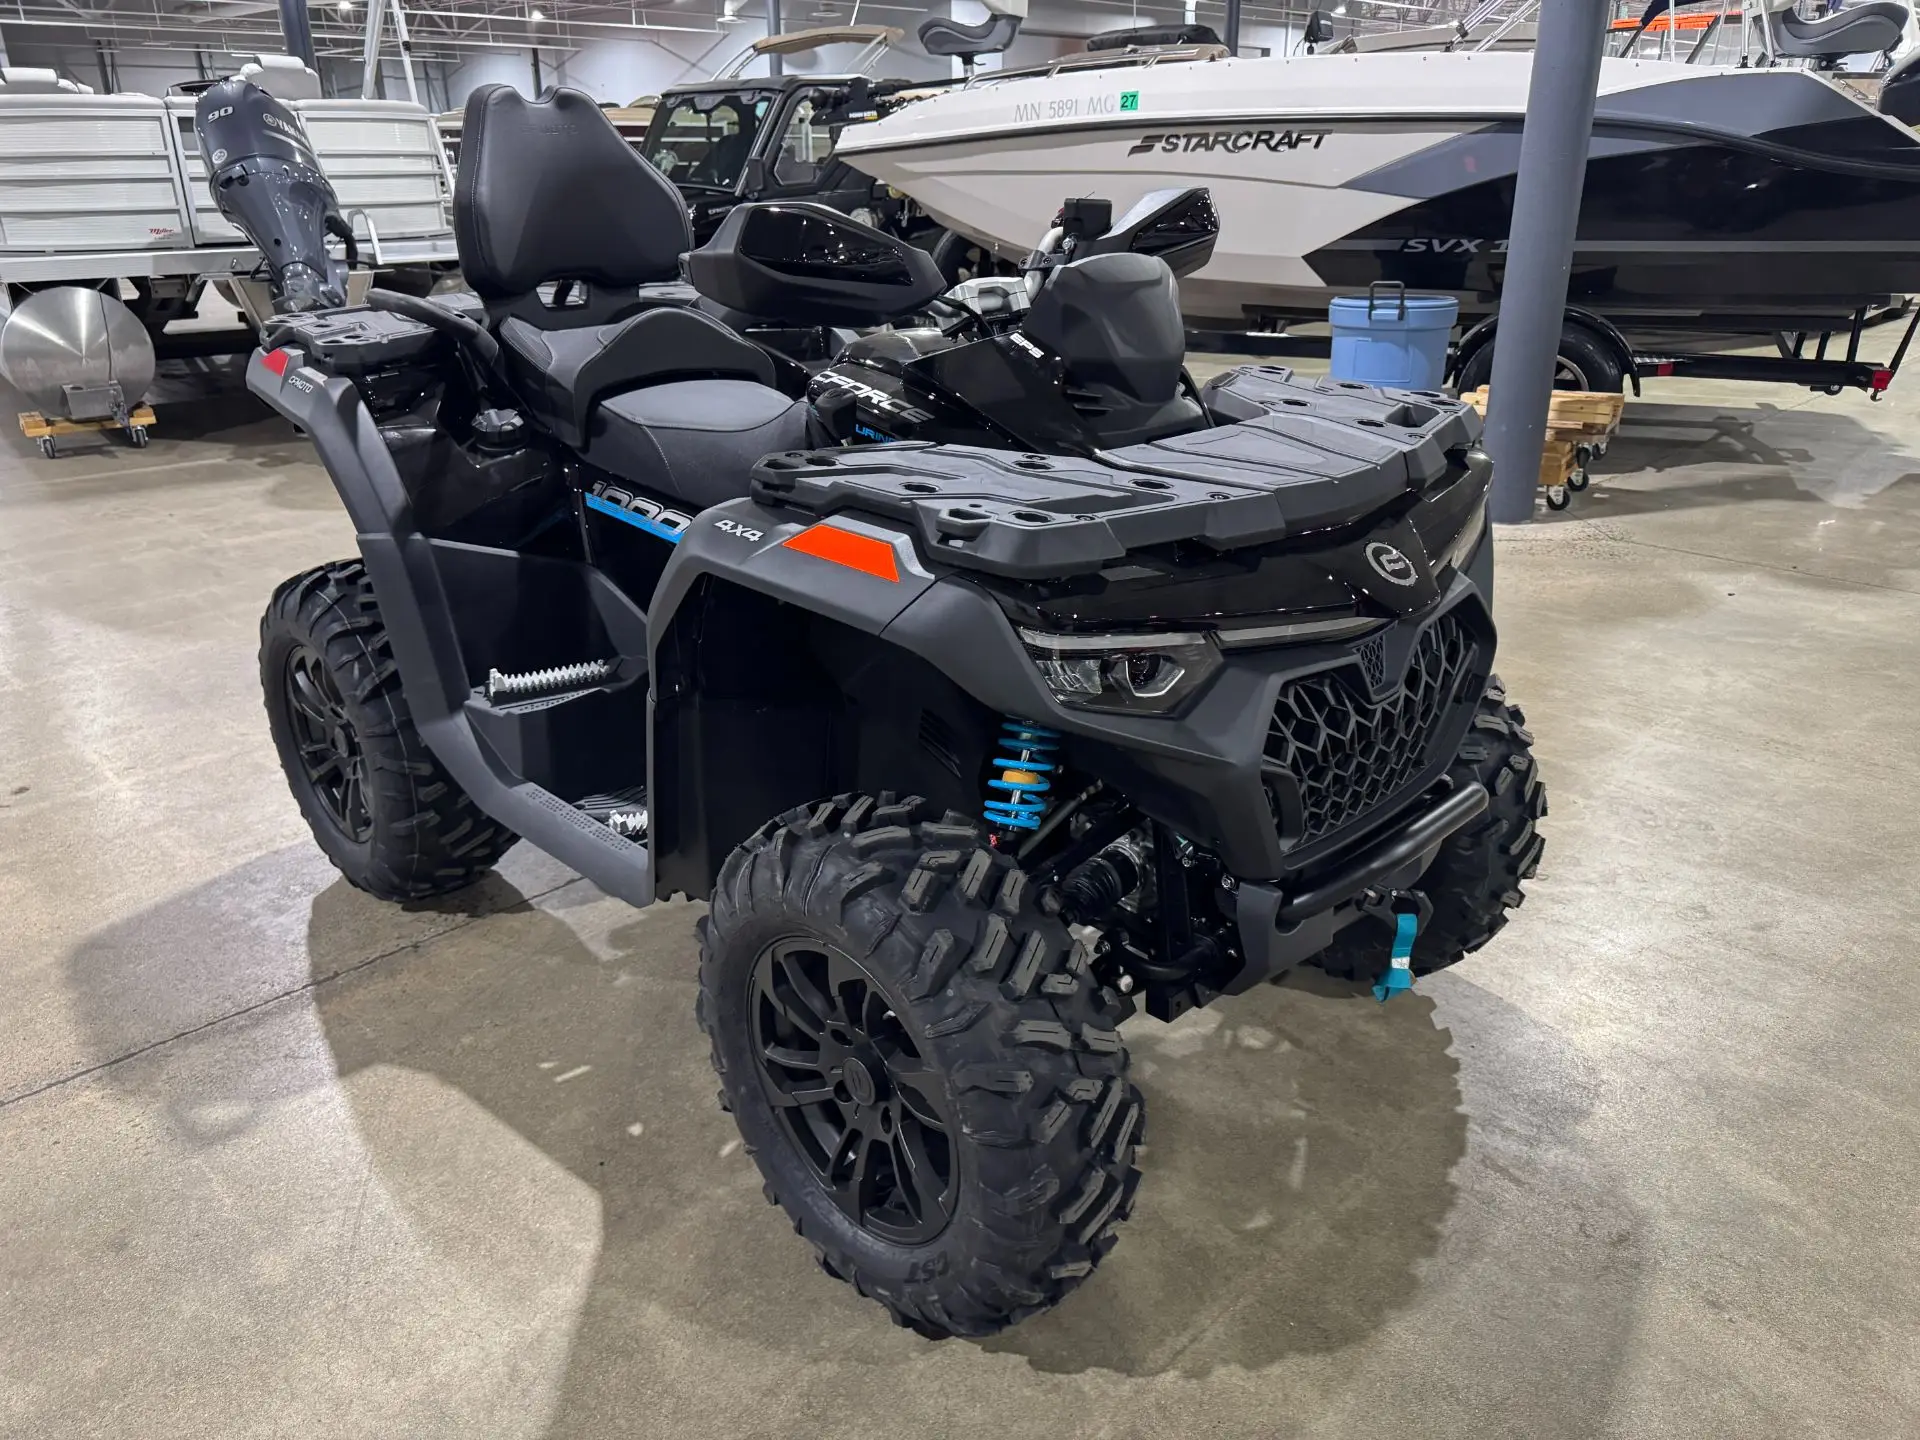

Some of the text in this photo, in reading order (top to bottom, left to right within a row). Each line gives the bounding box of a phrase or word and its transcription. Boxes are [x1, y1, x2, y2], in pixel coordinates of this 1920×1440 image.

[1014, 94, 1115, 122] MN 5891 MG
[1120, 94, 1137, 109] 27
[207, 106, 234, 123] 90
[275, 117, 310, 149] YAM
[1161, 129, 1334, 153] STARCRAFT
[1403, 238, 1485, 253] SVX
[1009, 332, 1045, 359] EPS
[288, 375, 314, 394] CFMOTO
[808, 371, 936, 423] CFORCE
[591, 480, 696, 536] 1000
